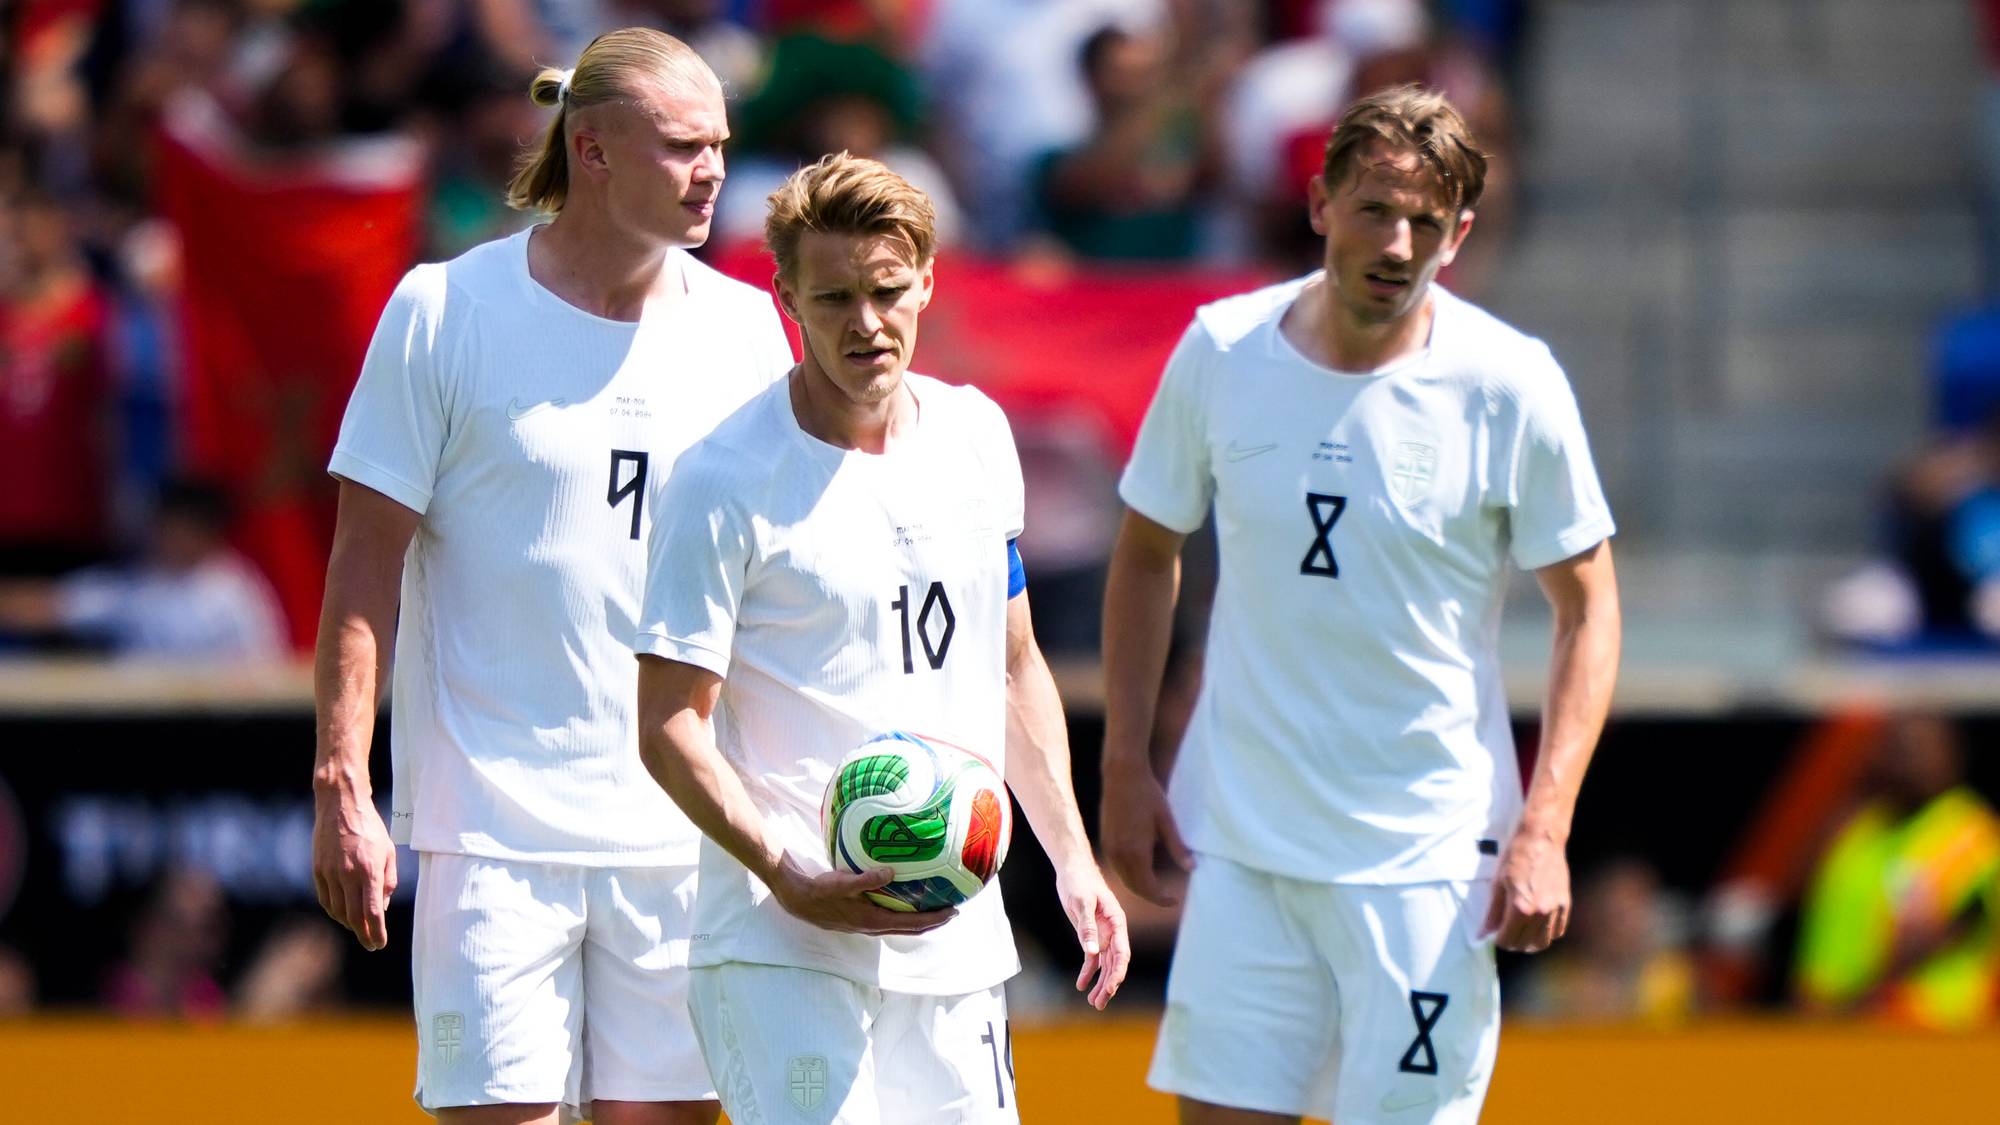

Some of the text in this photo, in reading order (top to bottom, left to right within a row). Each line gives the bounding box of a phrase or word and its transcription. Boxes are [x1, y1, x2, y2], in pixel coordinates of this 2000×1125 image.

[607, 449, 649, 540] 9
[1300, 492, 1348, 580] 8
[891, 581, 956, 674] 10
[1398, 990, 1449, 1076] 8
